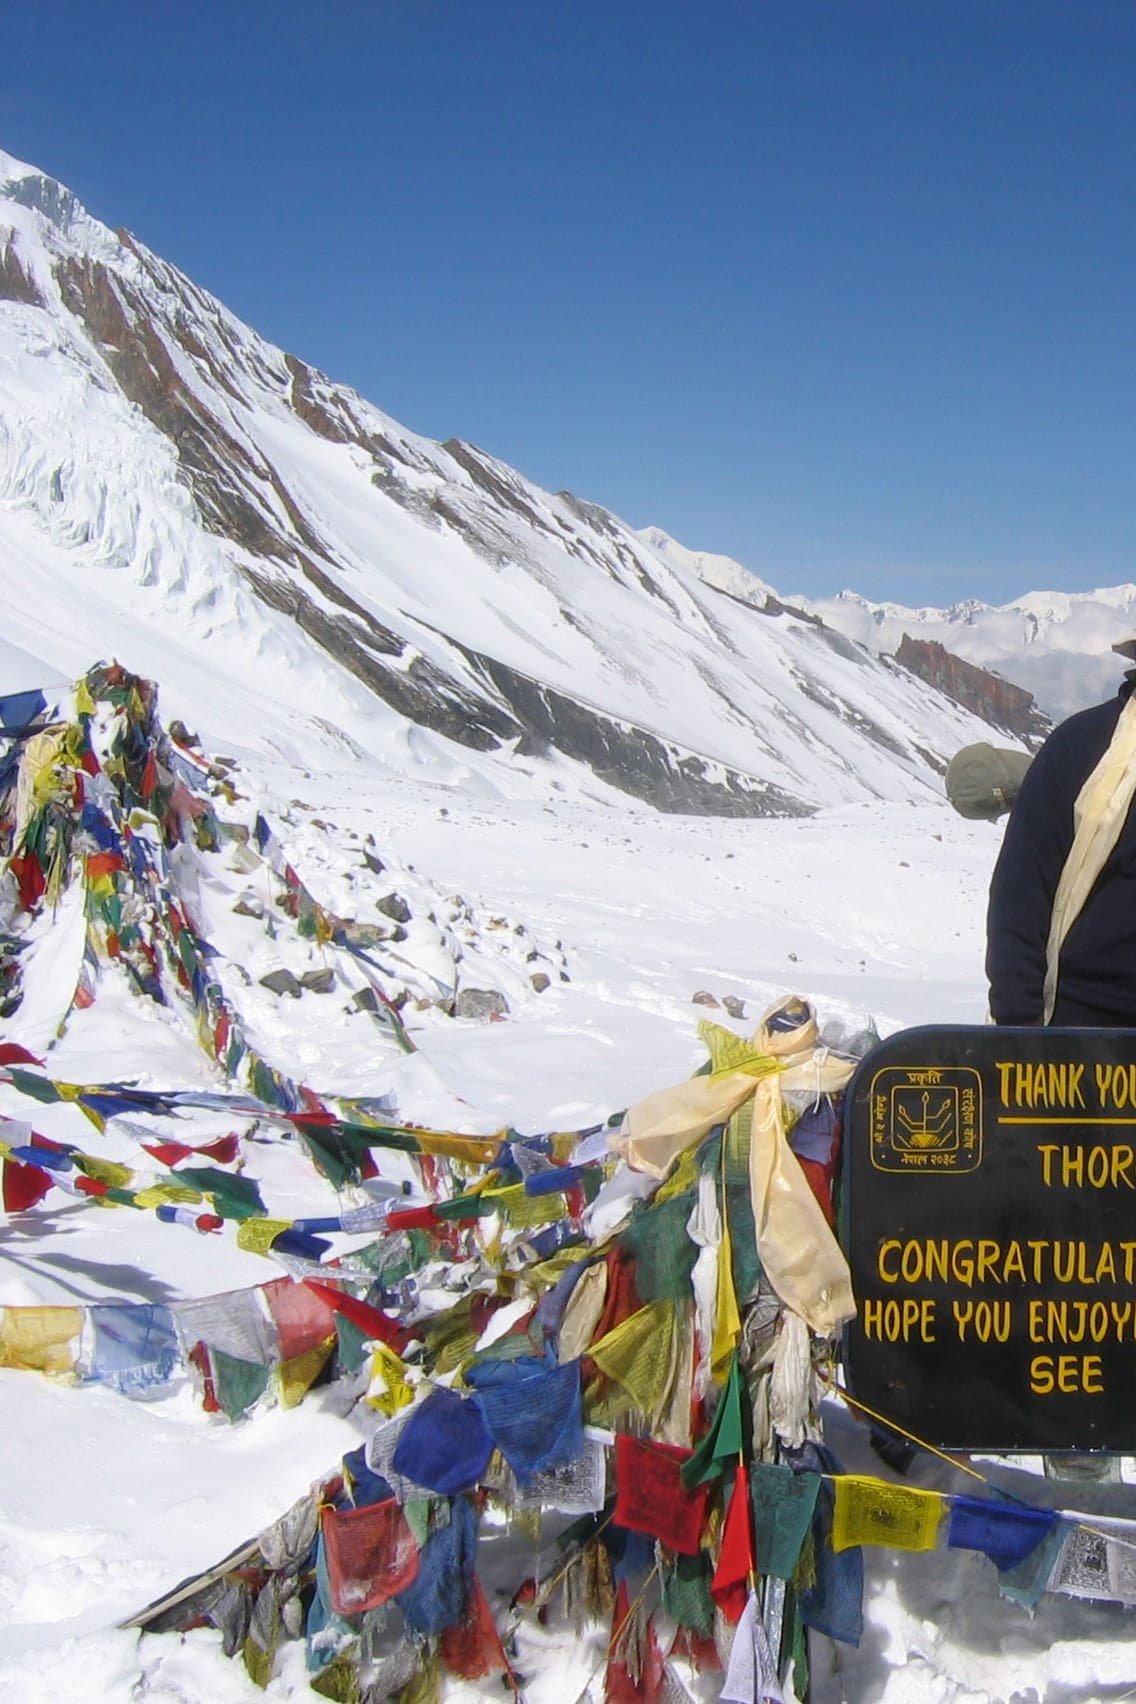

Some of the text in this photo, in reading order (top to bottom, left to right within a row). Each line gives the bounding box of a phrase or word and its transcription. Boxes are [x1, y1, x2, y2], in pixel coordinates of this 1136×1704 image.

[907, 1070, 944, 1086] प्रकृति
[994, 1061, 1085, 1109] THANK
[901, 1153, 928, 1166] नेपाल
[864, 1299, 936, 1343] HOPE
[952, 1300, 1011, 1343] YOU
[1030, 1355, 1104, 1394] SEE
